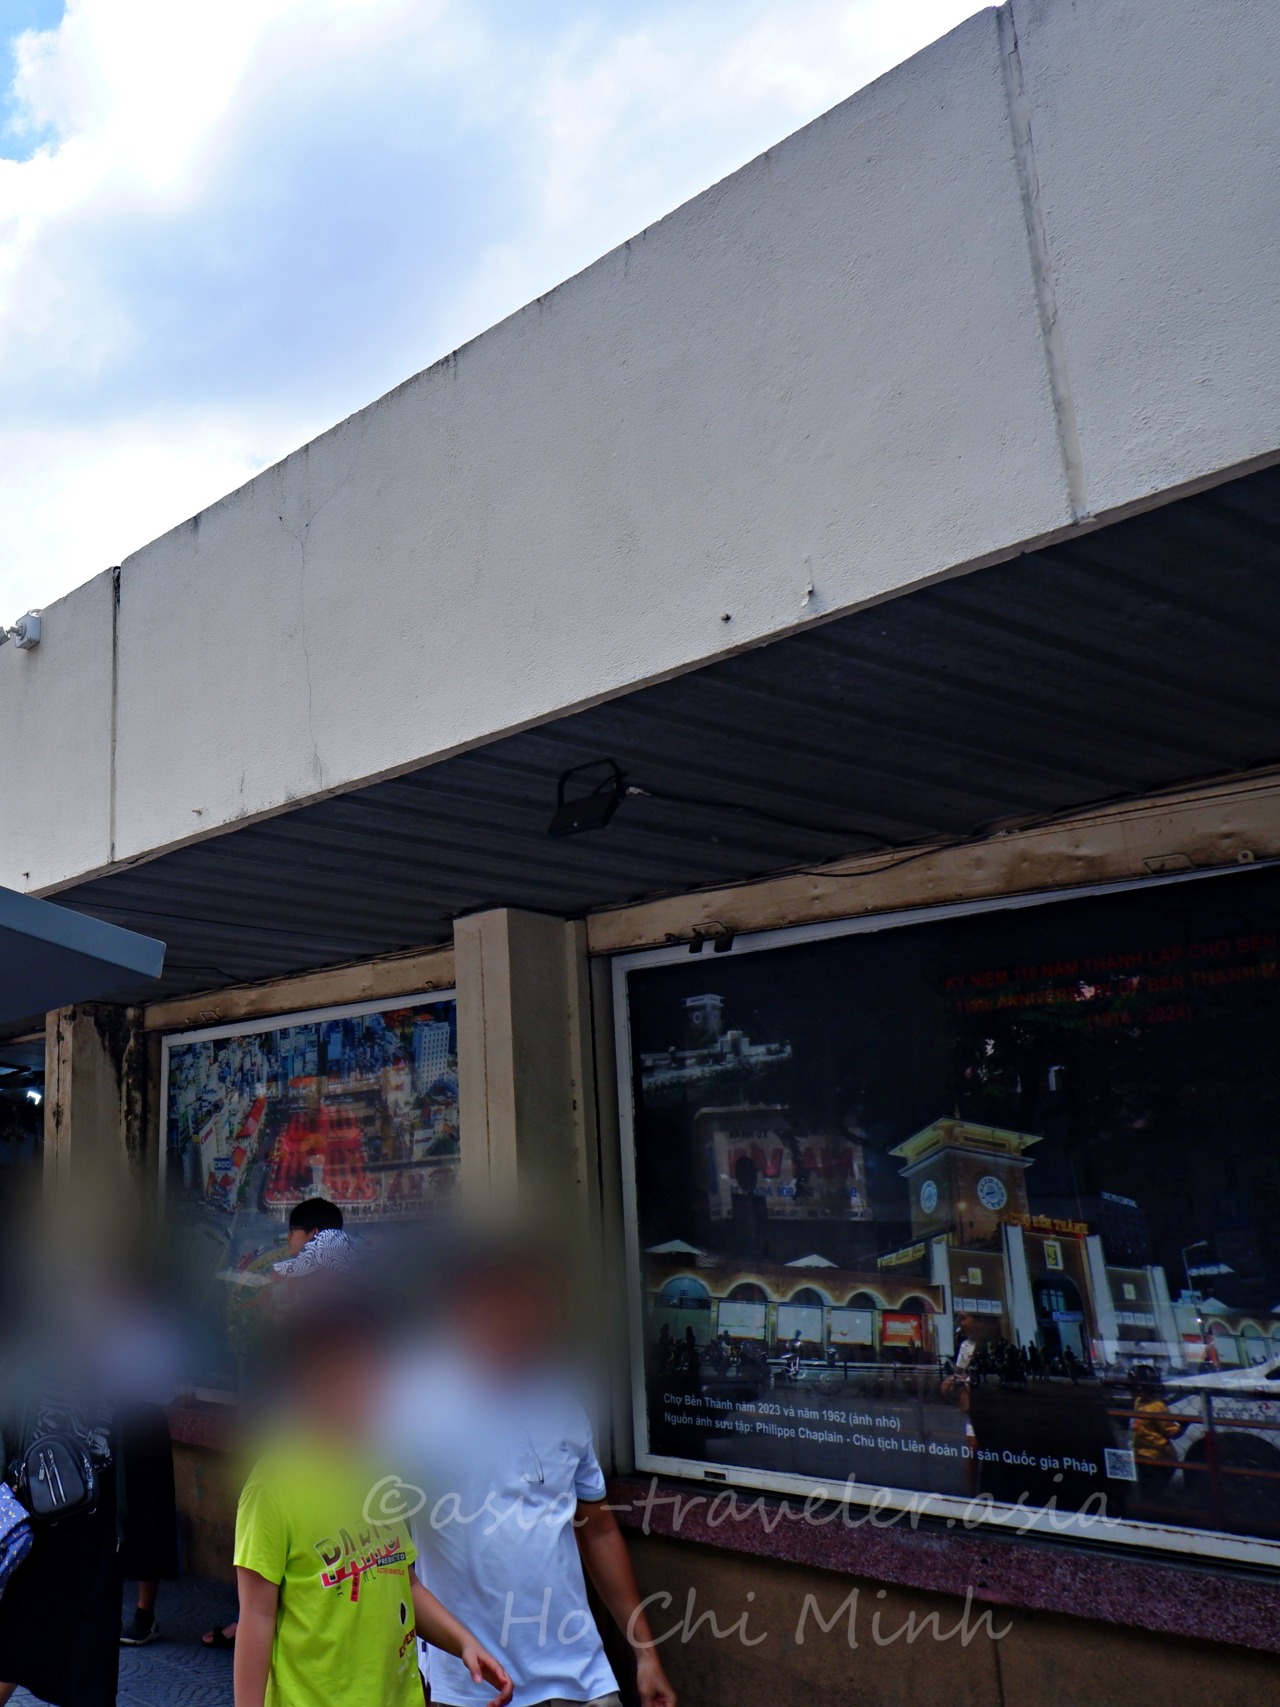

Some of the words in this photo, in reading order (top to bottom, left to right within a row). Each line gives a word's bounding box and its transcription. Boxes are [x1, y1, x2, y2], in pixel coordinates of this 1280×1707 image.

[663, 1392, 683, 1407] Chợ
[685, 1393, 703, 1407] Bến
[704, 1396, 733, 1411] Thành
[735, 1400, 756, 1413] năm
[757, 1402, 781, 1416] 2023
[783, 1405, 795, 1417] và
[797, 1407, 820, 1420] năm
[822, 1410, 846, 1423] 1962
[848, 1411, 872, 1427] (ảnh
[875, 1415, 901, 1431] nhỏ)
[664, 1412, 694, 1426] Nguồn
[695, 1413, 713, 1428] ảnh
[714, 1418, 734, 1430] sưu
[735, 1419, 754, 1434] tập:
[756, 1422, 796, 1438] Philippe
[798, 1427, 844, 1444] Chaplain
[853, 1433, 875, 1448] Chủ
[877, 1436, 899, 1451] tịch
[901, 1439, 926, 1454] Liên
[928, 1442, 958, 1457] đoàn
[961, 1446, 974, 1459] Di
[977, 1447, 999, 1462] sản
[1002, 1449, 1037, 1467] Quốc
[1040, 1455, 1060, 1471] gia
[1063, 1457, 1098, 1475] Pháp
